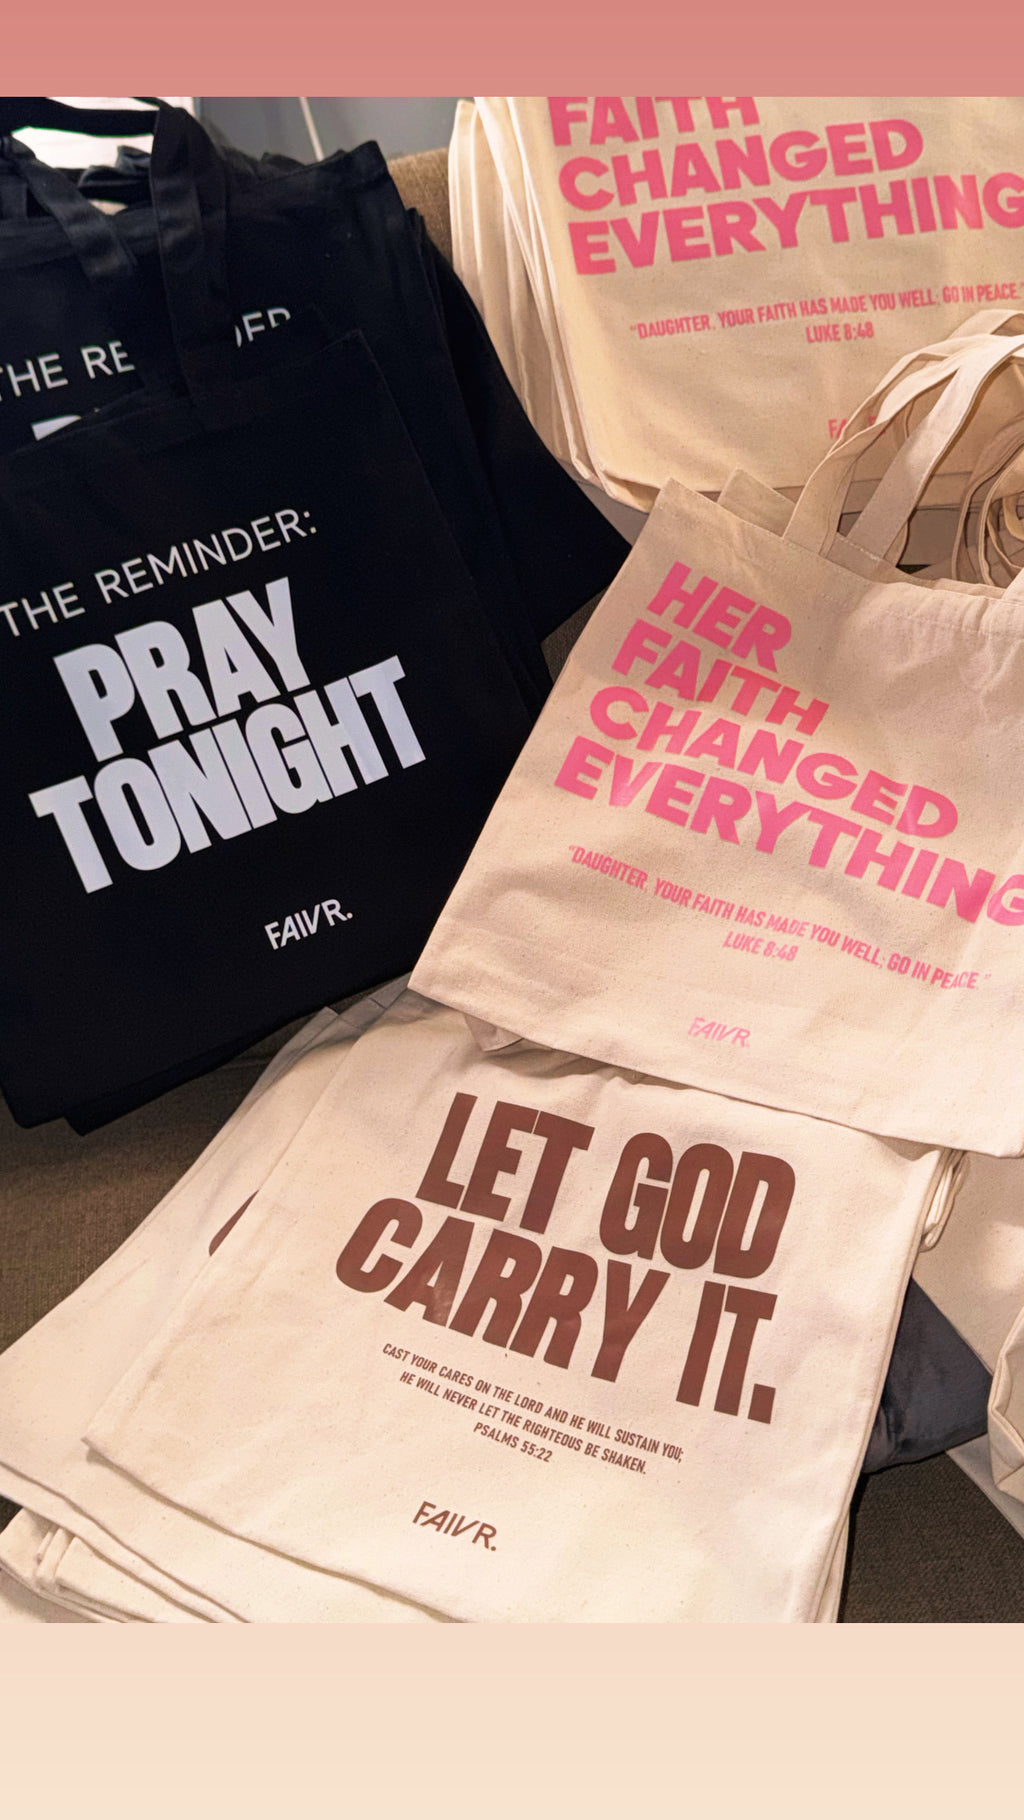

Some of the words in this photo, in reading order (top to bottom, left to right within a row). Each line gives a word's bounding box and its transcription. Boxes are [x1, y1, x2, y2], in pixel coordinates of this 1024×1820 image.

[547, 97, 760, 147] FAITH
[558, 118, 924, 212] CHANGED
[568, 172, 1024, 276] EVERYTHING
[717, 308, 756, 329] YOUR
[757, 301, 798, 324] FAITH
[799, 297, 828, 318] HAS
[829, 294, 868, 314] MADE
[869, 292, 897, 312] YOU
[943, 284, 961, 305] GO
[962, 285, 975, 304] IN
[805, 325, 841, 344] LUKE
[843, 321, 875, 340] 8:48
[0, 582, 86, 637] THE
[94, 507, 318, 604] REMINDER:
[645, 560, 793, 674] HER
[52, 576, 311, 762] PRAY
[611, 618, 831, 737] FAITH
[28, 654, 427, 895] TONIGHT
[589, 685, 959, 840] CHANGED
[553, 735, 1024, 927] EVERYTHING
[653, 876, 693, 908] YOUR
[692, 893, 735, 920] FAITH
[735, 905, 767, 927] HAS
[766, 913, 810, 937] MADE
[810, 923, 841, 948] YOU
[887, 952, 911, 975] GO
[911, 960, 932, 981] IN
[722, 931, 764, 955] LUKE
[762, 940, 799, 963] 8:48
[415, 1092, 596, 1235] LET
[599, 1132, 796, 1279] GOD
[335, 1197, 671, 1383] CARRY
[675, 1280, 778, 1424] IT.
[382, 1343, 411, 1362] CAST
[410, 1354, 438, 1374] YOUR
[438, 1366, 474, 1387] CARES
[474, 1379, 492, 1395] ON
[492, 1386, 514, 1403] THE
[513, 1394, 544, 1414] LORD
[543, 1406, 569, 1424] AND
[569, 1414, 586, 1430] HE
[586, 1419, 612, 1439] WILL
[614, 1429, 660, 1454] SUSTAIN
[661, 1442, 684, 1463] YOU;
[399, 1371, 416, 1385] HE
[415, 1376, 441, 1397] WILL
[442, 1388, 478, 1411] NEVER
[478, 1402, 501, 1419] LET
[500, 1410, 523, 1428] THE
[522, 1419, 584, 1452] RIGHTEOUS
[583, 1442, 601, 1459] BE
[601, 1448, 647, 1475] SHAKEN.
[473, 1422, 520, 1448] PSALMS
[520, 1440, 553, 1463] 55:22
[412, 1501, 498, 1551] FAIVR.
